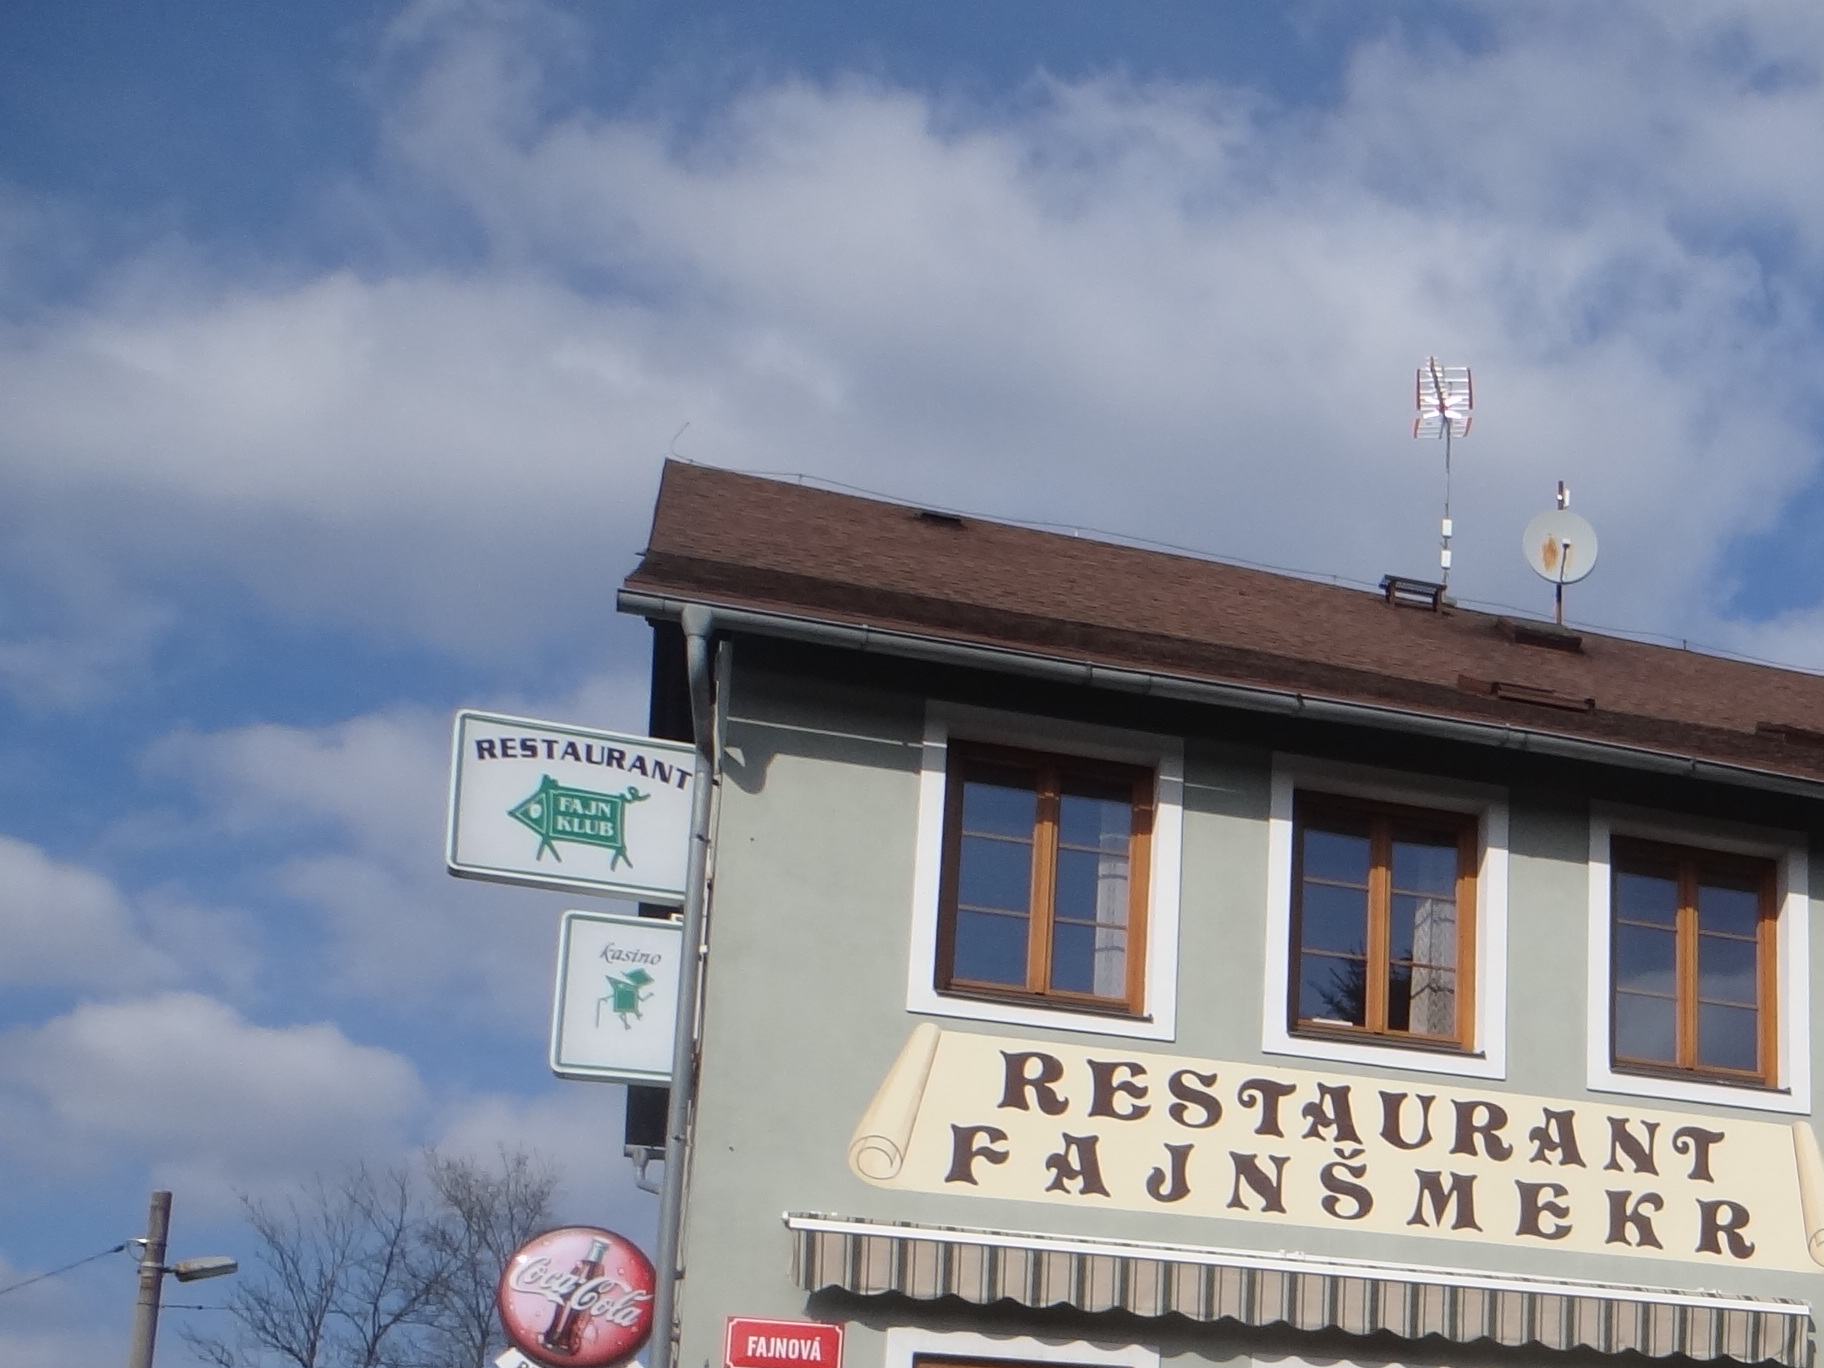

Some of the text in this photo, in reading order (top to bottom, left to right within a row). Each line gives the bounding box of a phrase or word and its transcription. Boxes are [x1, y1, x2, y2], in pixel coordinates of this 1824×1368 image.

[474, 737, 693, 790] RESTAURANT
[557, 815, 614, 837] KLUB
[559, 796, 611, 817] FAJN
[997, 1048, 1726, 1184] RESTAURANT
[943, 1123, 1758, 1261] FAJNŠMEKR
[747, 1335, 822, 1362] FAJNOVÁ
